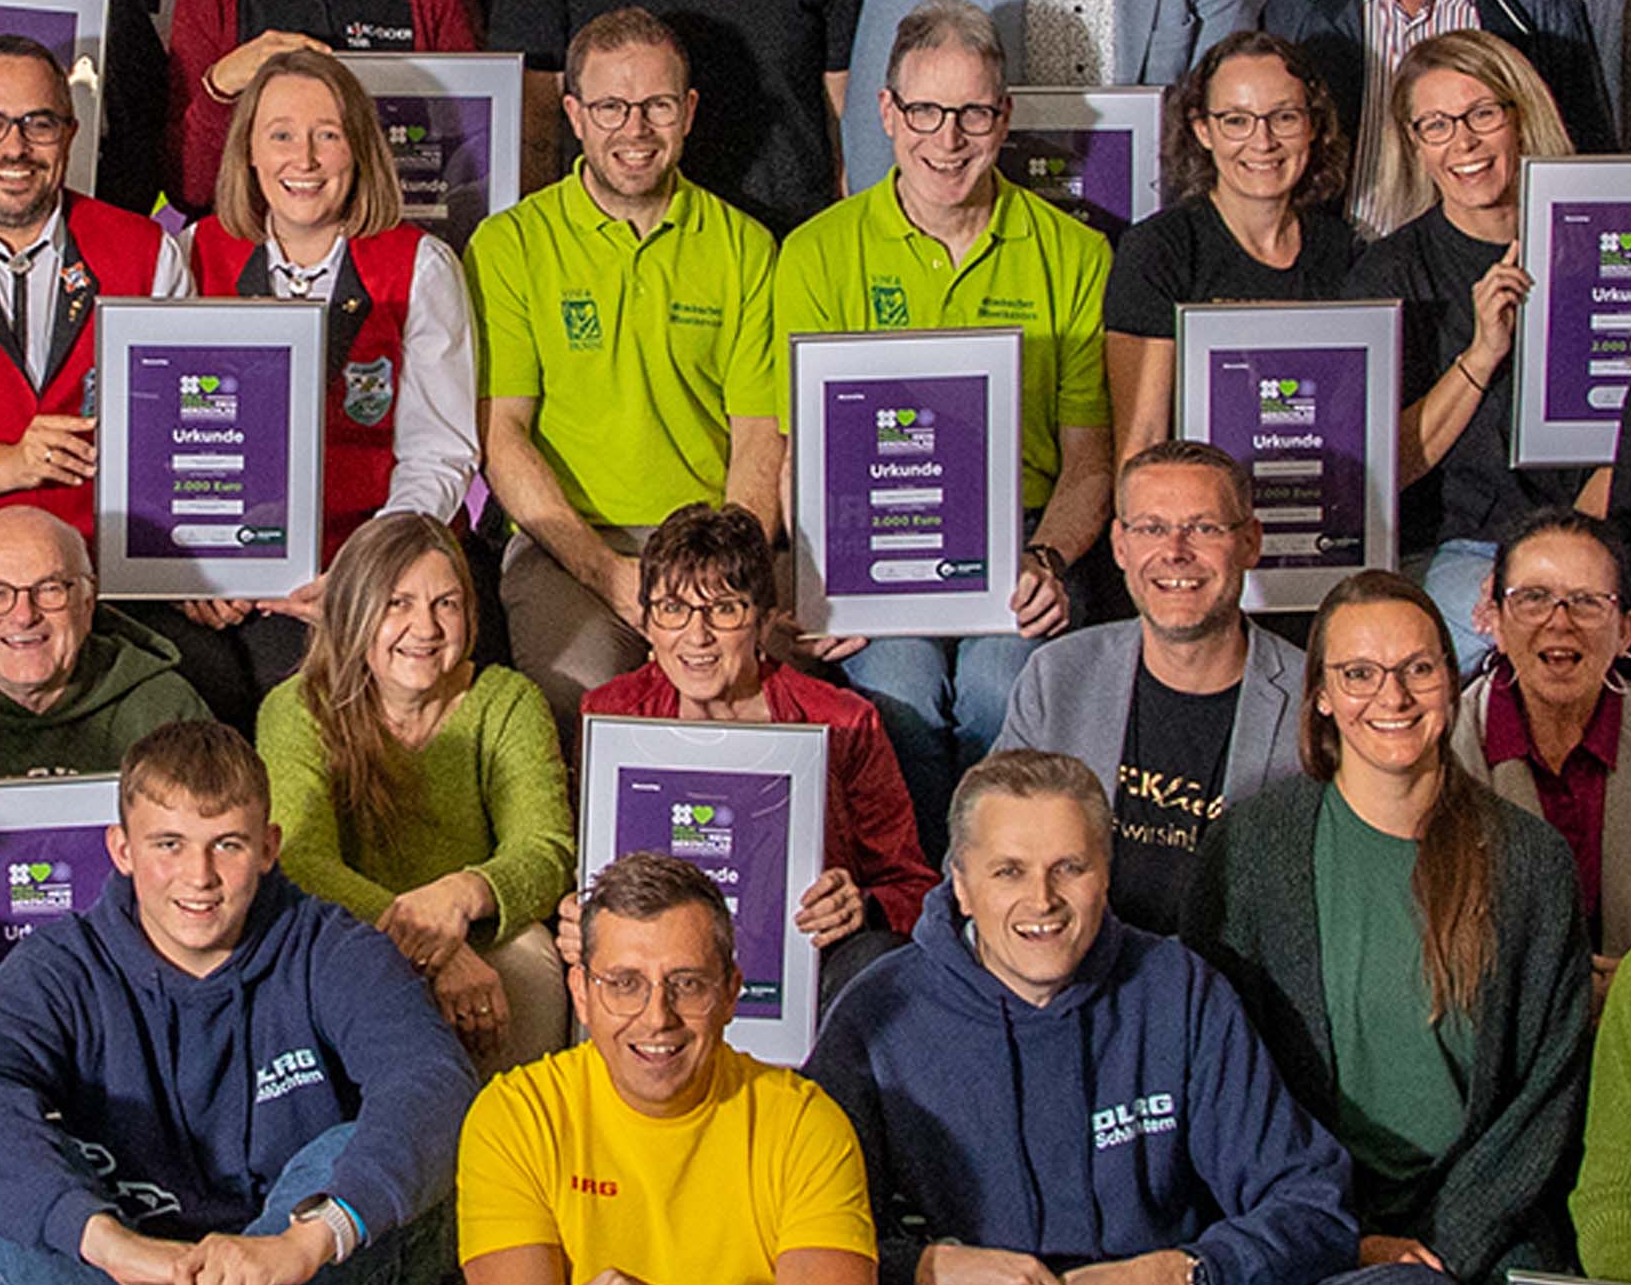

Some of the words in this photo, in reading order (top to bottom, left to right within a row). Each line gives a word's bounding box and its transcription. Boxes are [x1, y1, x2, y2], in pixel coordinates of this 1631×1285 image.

[1591, 341, 1626, 352] 2.000
[173, 428, 244, 444] Urkunde
[1253, 433, 1322, 449] Urkunde
[870, 462, 942, 478] Urkunde
[174, 481, 210, 492] 2.000
[872, 515, 909, 527] 2.000
